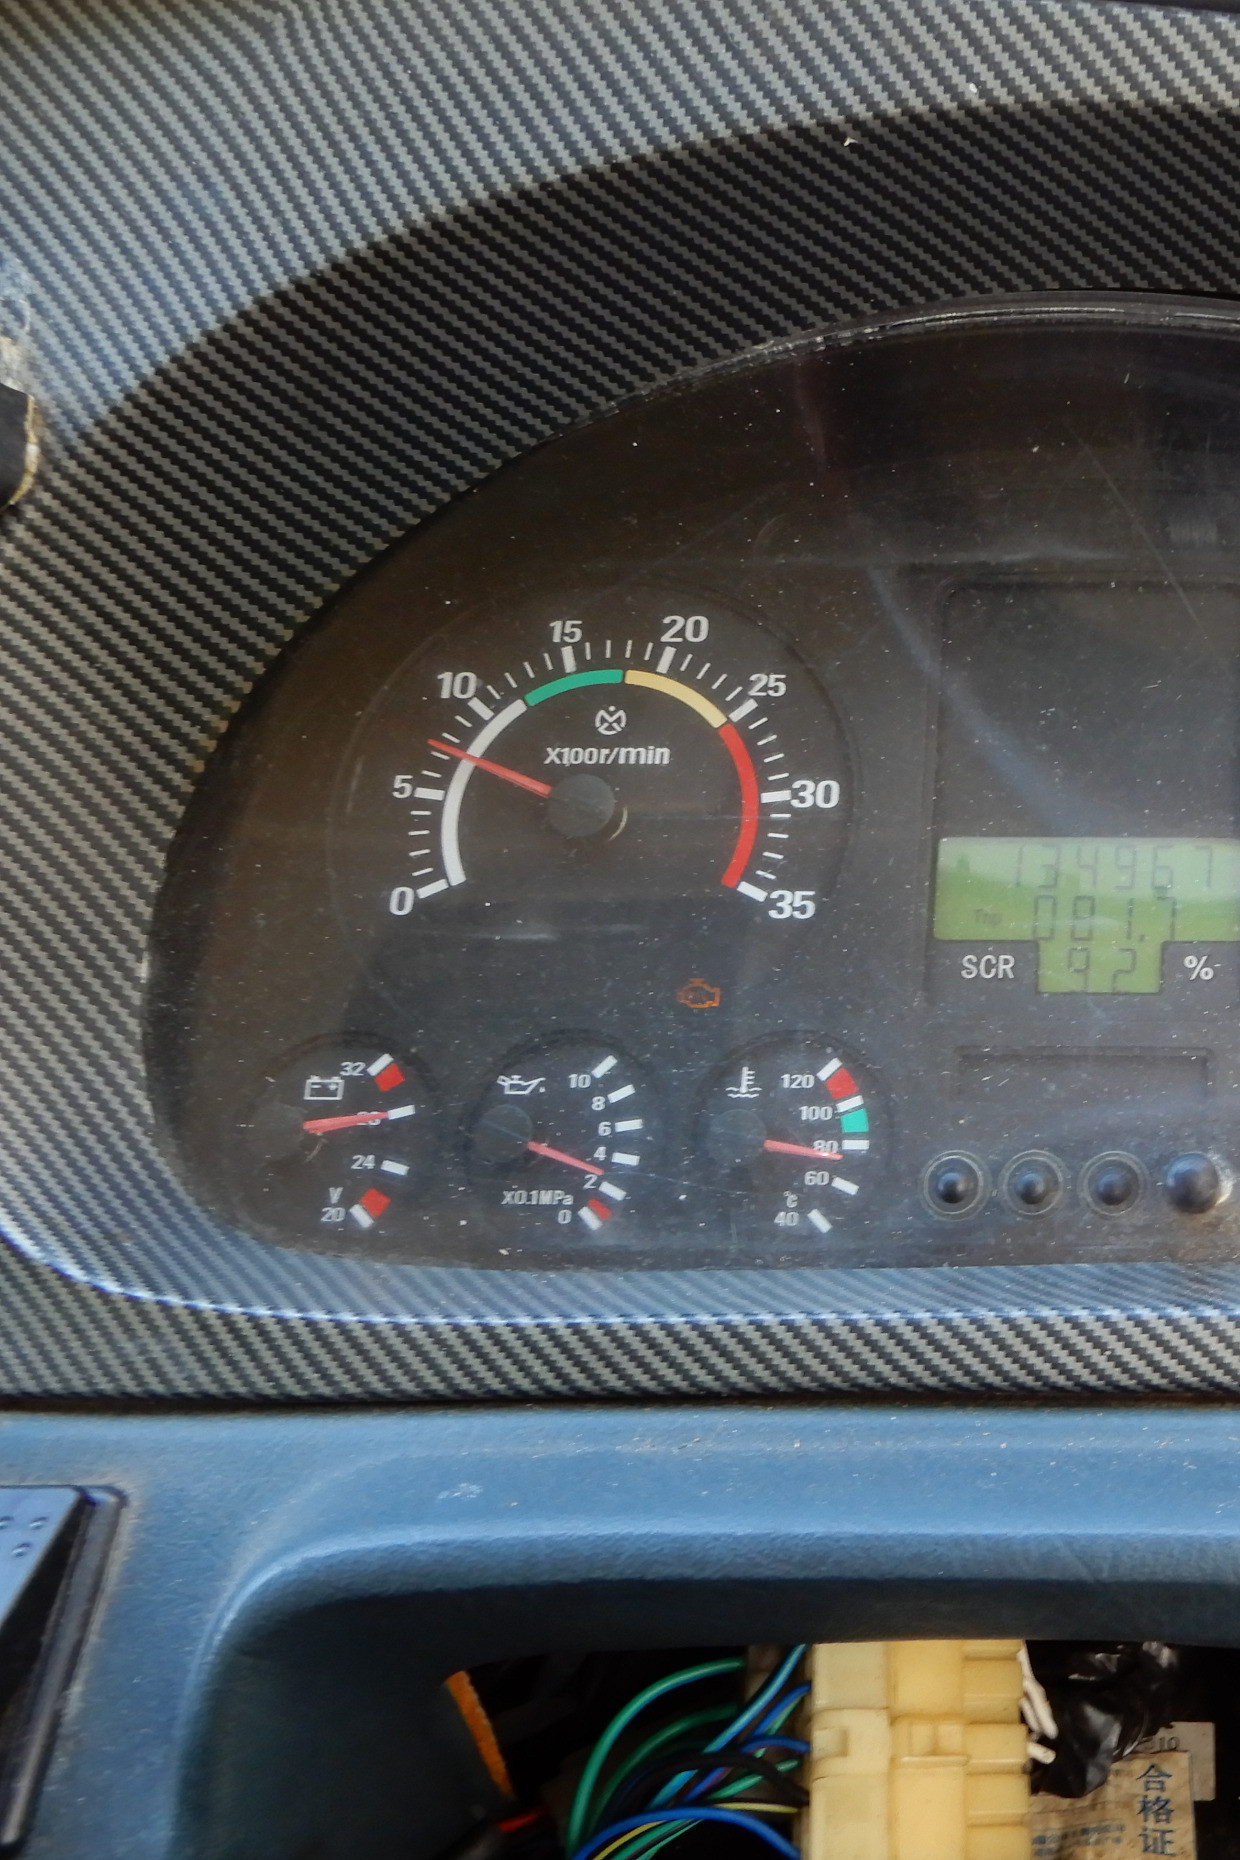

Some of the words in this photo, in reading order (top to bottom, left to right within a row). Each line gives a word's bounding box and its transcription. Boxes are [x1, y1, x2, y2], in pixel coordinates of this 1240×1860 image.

[550, 620, 583, 643] 15
[661, 615, 710, 643] 20
[437, 671, 477, 699] 10
[748, 673, 787, 698] 25
[392, 775, 413, 799] 5
[790, 779, 840, 809] 30
[389, 886, 415, 916] 0
[768, 890, 816, 920] 35
[961, 954, 1015, 980] SCR
[1183, 955, 1214, 981] %
[340, 1061, 366, 1076] 32
[568, 1073, 592, 1088] 10
[780, 1074, 815, 1089] 120
[591, 1096, 606, 1111] 8
[799, 1105, 833, 1120] 100
[598, 1121, 612, 1136] 6
[593, 1146, 607, 1160] 4
[813, 1140, 839, 1154] 80
[351, 1154, 376, 1170] 24
[583, 1174, 598, 1189] 2
[804, 1170, 829, 1186] 60
[329, 1187, 344, 1204] V
[320, 1207, 346, 1222] 20
[557, 1209, 572, 1224] 0
[774, 1211, 799, 1226] 40
[1136, 1763, 1176, 1858] 合格证
